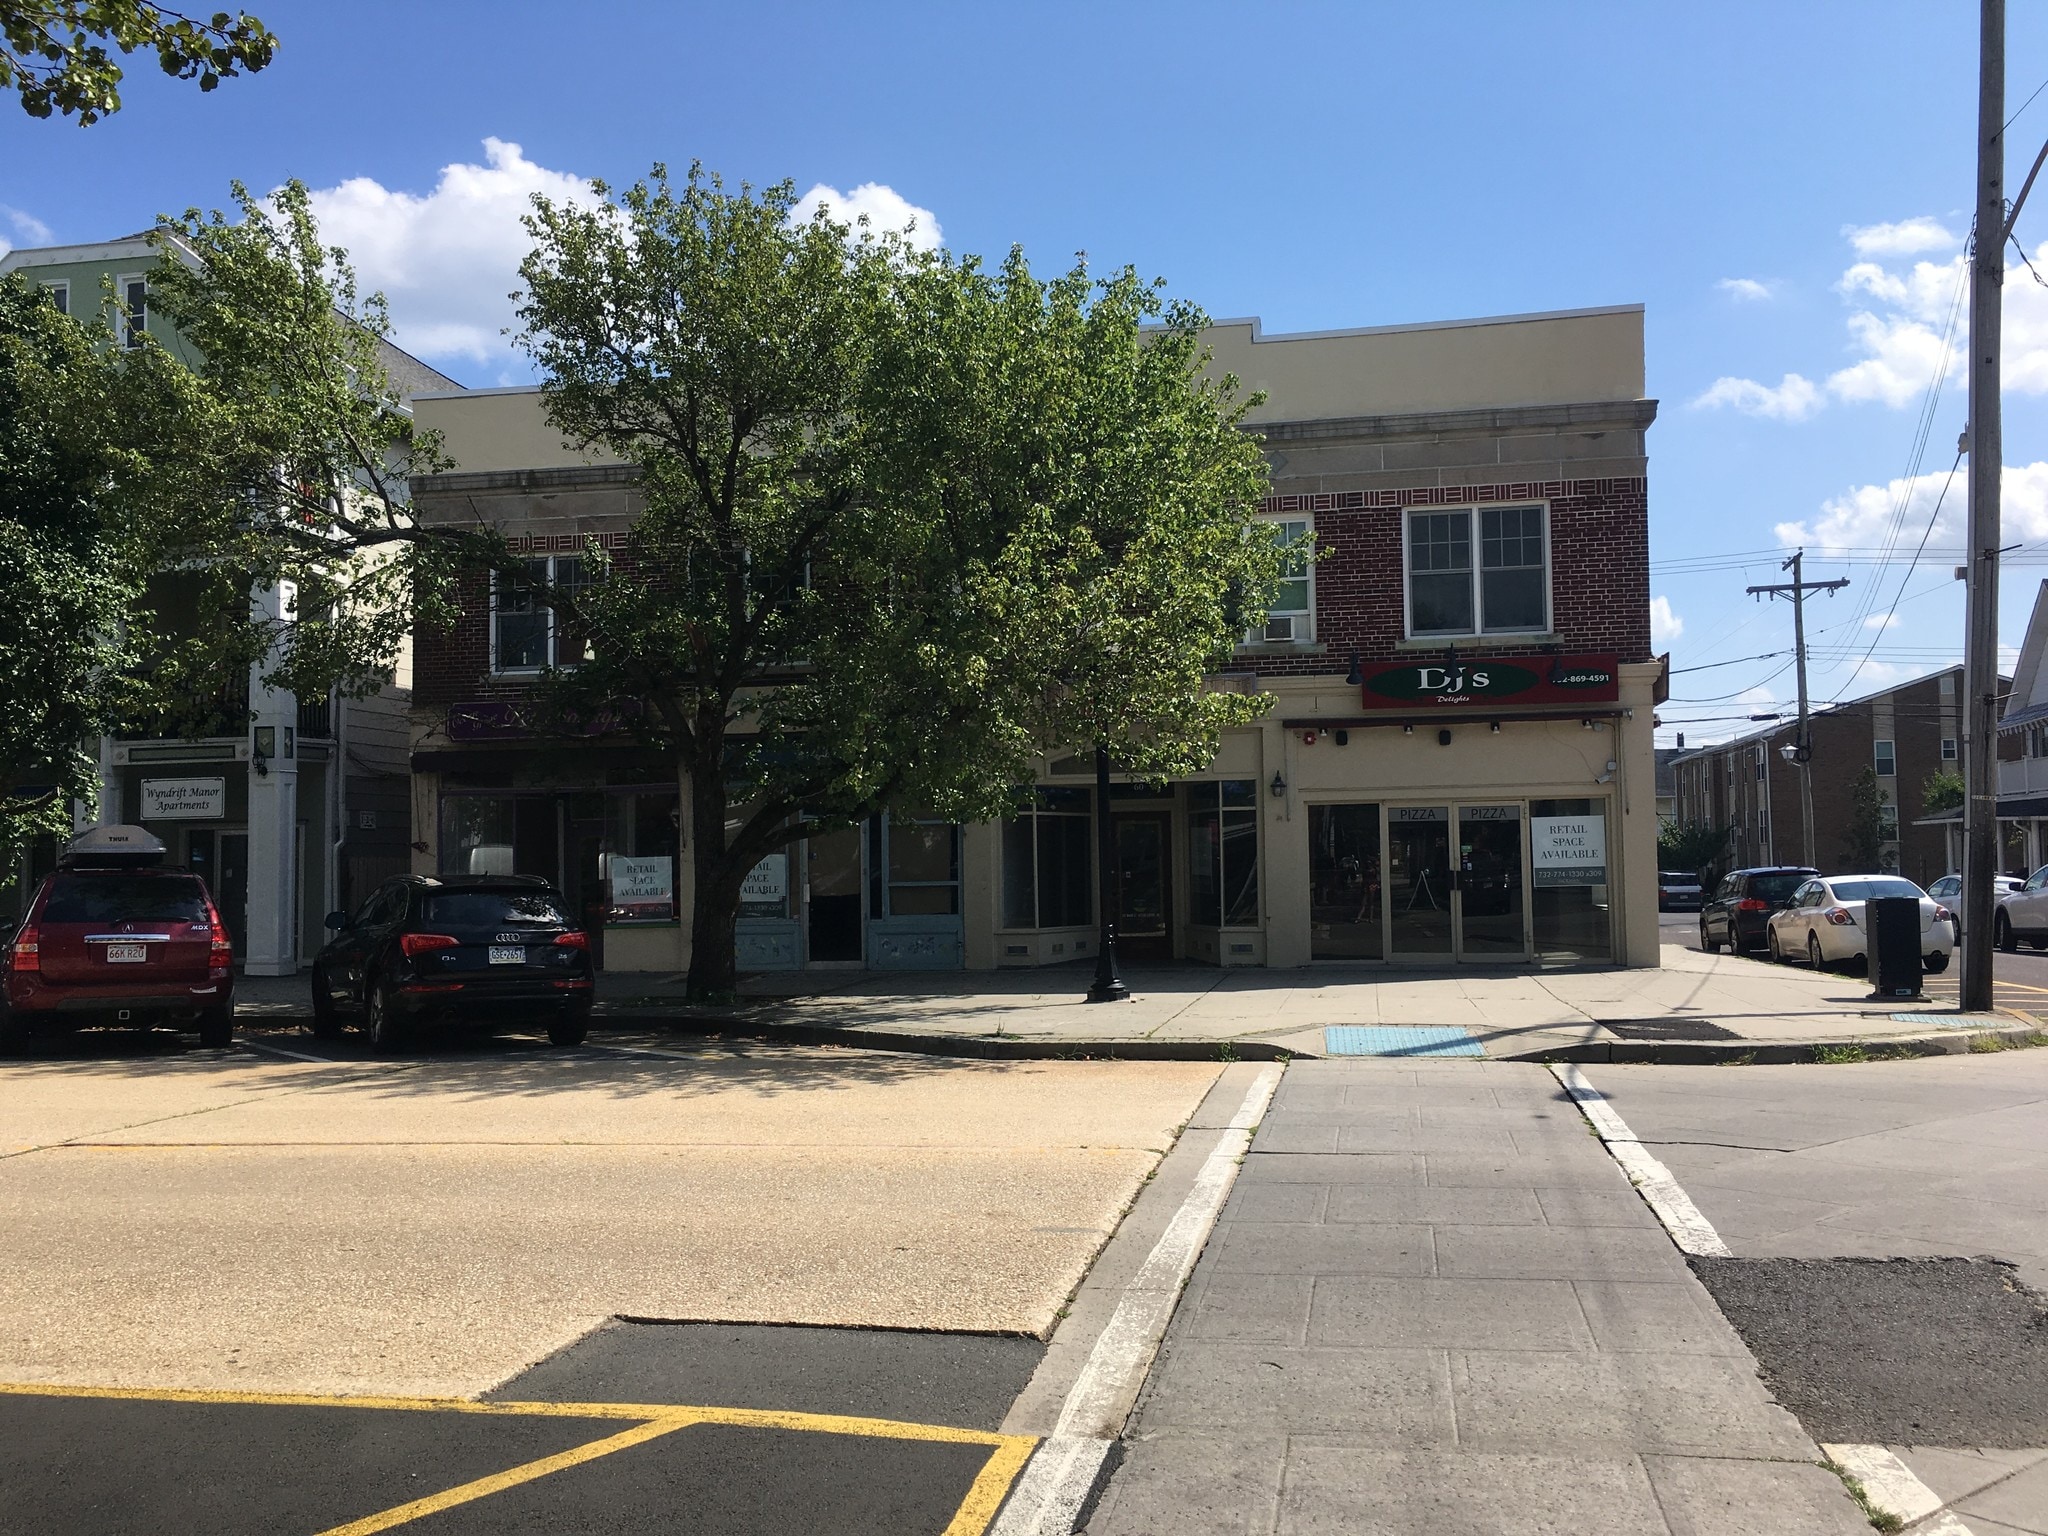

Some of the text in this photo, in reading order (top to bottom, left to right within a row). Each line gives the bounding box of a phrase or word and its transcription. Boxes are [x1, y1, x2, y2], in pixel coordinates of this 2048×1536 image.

[1552, 674, 1609, 684] 2-869-4591
[1435, 695, 1470, 704] Delights
[145, 787, 220, 799] Wyndrift Manor
[155, 801, 210, 813] Apartments
[1400, 809, 1436, 820] PIZZA
[1471, 808, 1508, 819] PIZZA
[1549, 825, 1588, 835] RETAIL
[1552, 837, 1585, 847] SPACE
[1540, 849, 1599, 860] AVAILABLE
[626, 865, 658, 873] RETAIL
[629, 876, 656, 885] SPACE
[619, 888, 667, 897] AVAILABLE
[742, 885, 780, 895] AILABLE
[109, 949, 126, 959] 66K
